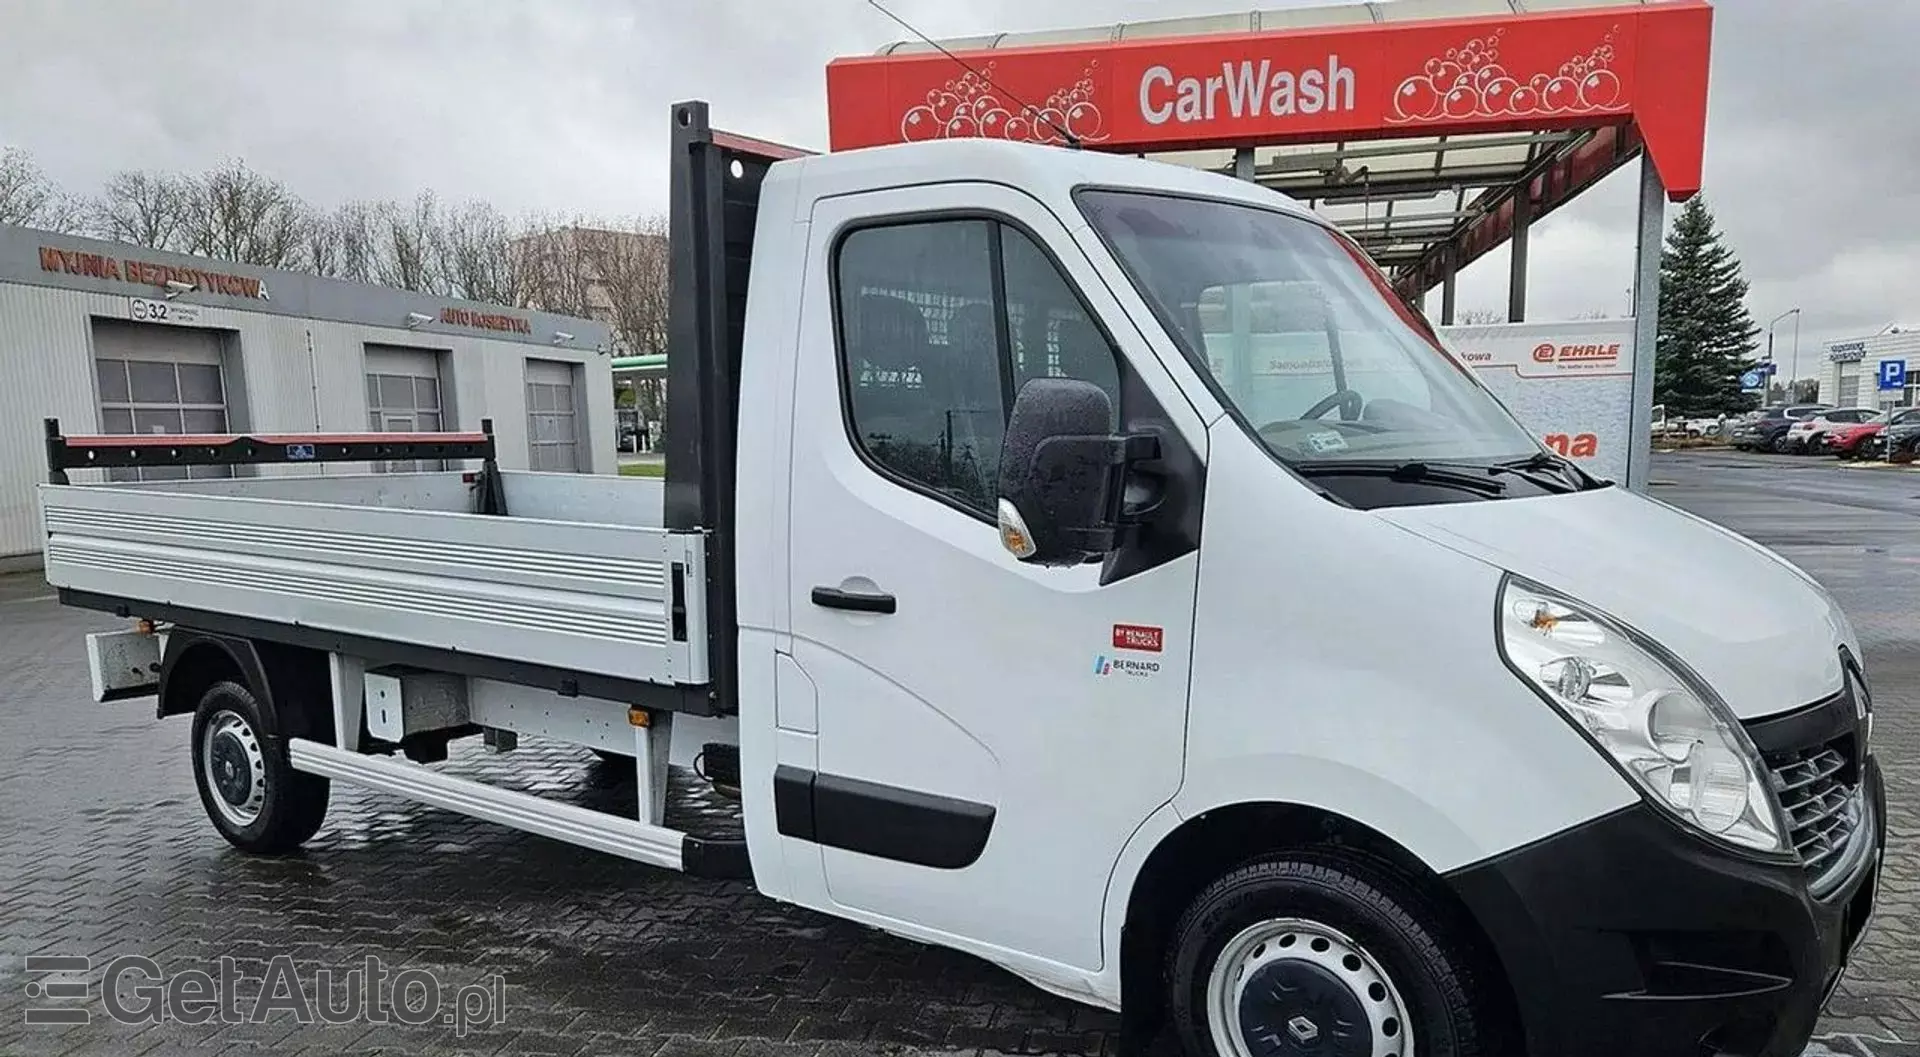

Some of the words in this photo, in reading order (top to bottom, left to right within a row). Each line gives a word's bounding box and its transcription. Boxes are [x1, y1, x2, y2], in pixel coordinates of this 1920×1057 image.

[1139, 54, 1356, 124] CarWash
[39, 247, 122, 281] MYJNIA
[1560, 344, 1620, 357] EHRLE
[1886, 363, 1900, 382] P
[1113, 660, 1160, 672] BERNARD
